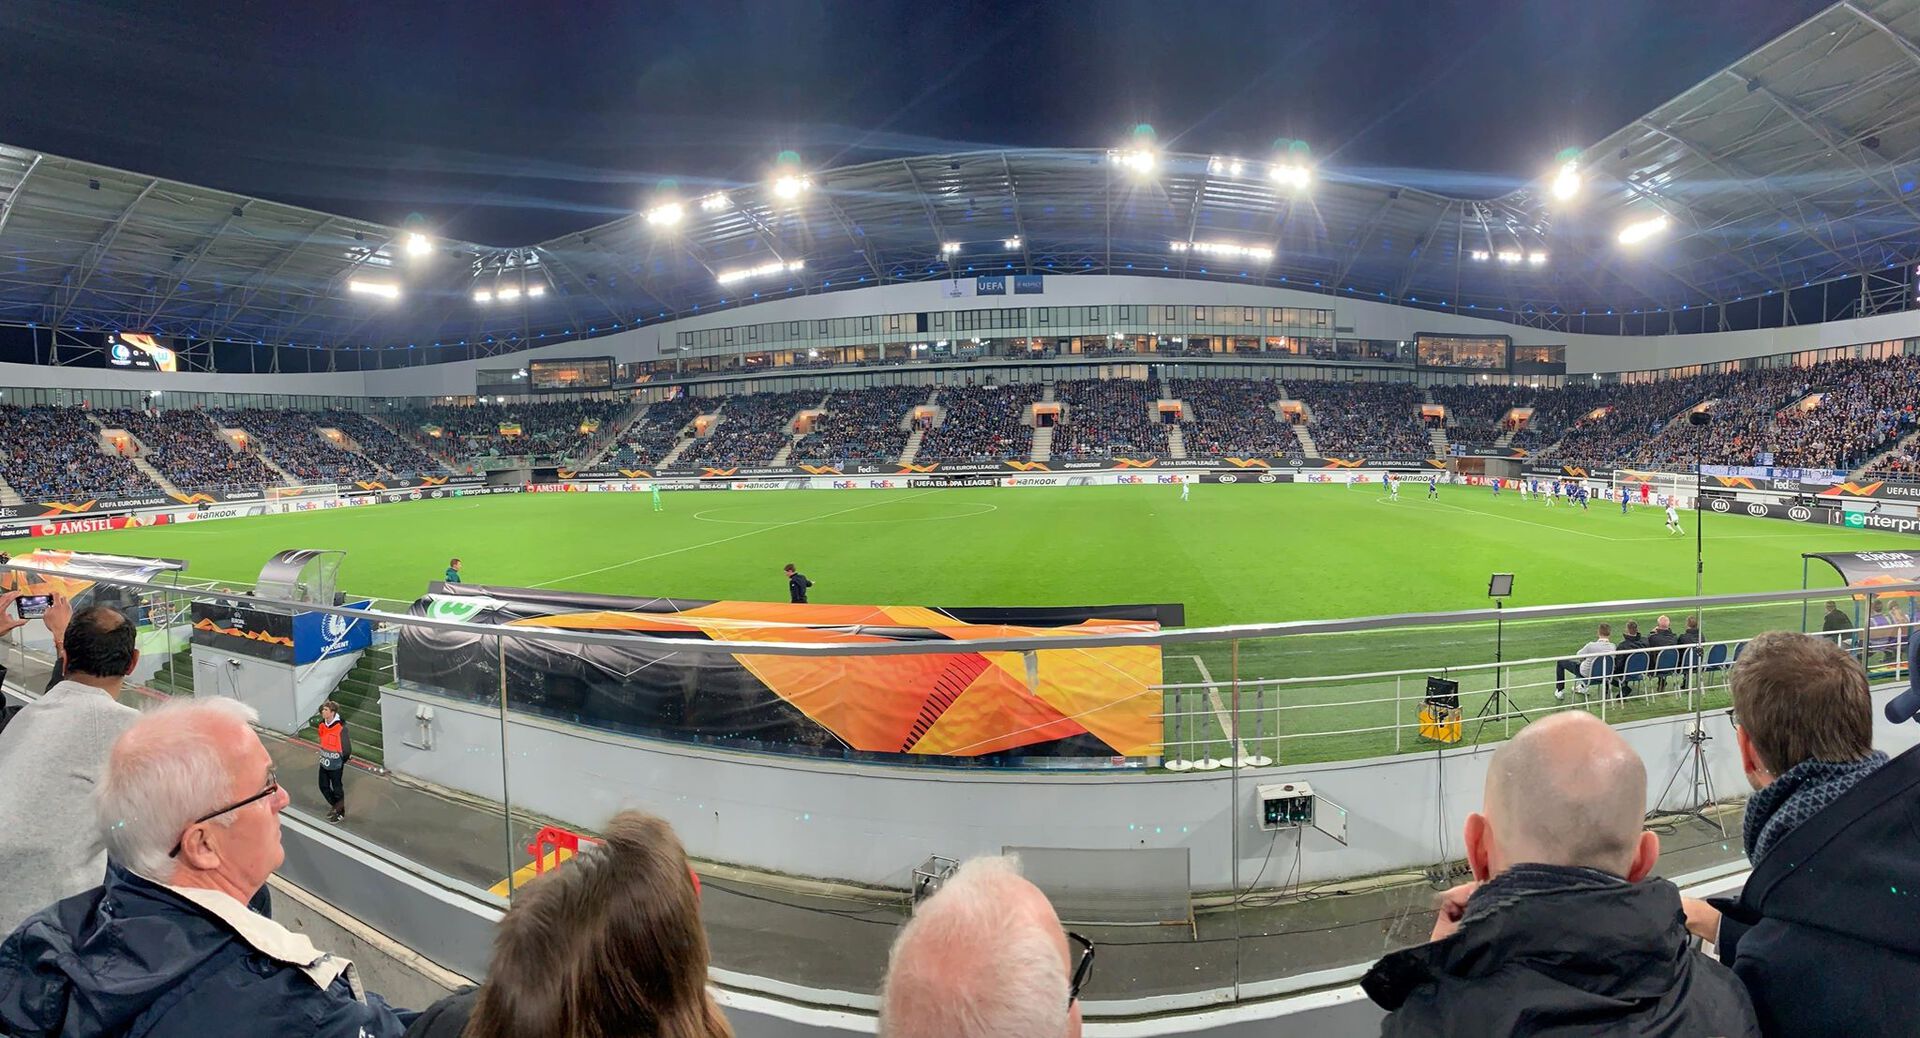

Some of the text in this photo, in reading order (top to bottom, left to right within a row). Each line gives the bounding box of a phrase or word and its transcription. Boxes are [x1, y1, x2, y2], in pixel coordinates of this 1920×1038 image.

[978, 281, 1004, 290] UEFA
[963, 479, 992, 487] LEAGUE
[1118, 474, 1183, 484] FedEx FedEx
[1308, 474, 1332, 483] FedEx
[537, 484, 564, 493] AMSTEL
[658, 483, 695, 491] nterprise
[870, 480, 895, 488] FedEx
[1886, 487, 1920, 496] UEFA EU
[296, 501, 317, 511] FedEx
[1791, 509, 1808, 519] KIA
[60, 518, 114, 534] AMSTEL
